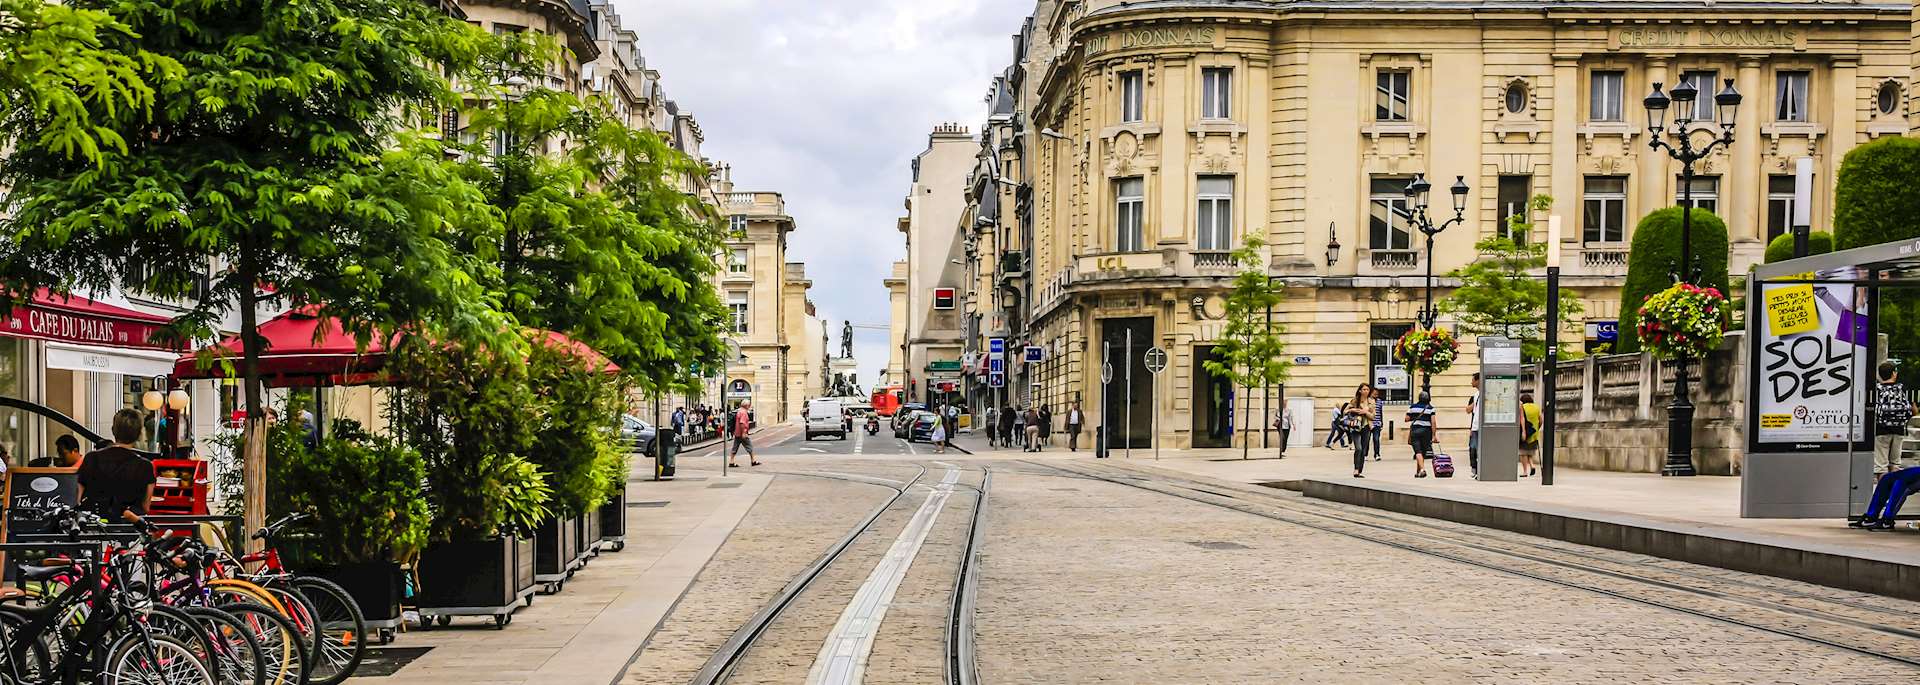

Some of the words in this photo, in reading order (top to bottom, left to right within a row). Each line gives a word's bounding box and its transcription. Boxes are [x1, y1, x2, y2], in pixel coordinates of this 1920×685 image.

[1121, 26, 1216, 48] LYONNAIS
[1699, 29, 1797, 46] LYONNAIS
[1097, 256, 1128, 271] LCL
[61, 315, 78, 339] DU
[79, 319, 115, 342] PALAIS
[1597, 324, 1617, 332] LCL
[1764, 334, 1852, 371] SOL
[1768, 364, 1852, 403] DES
